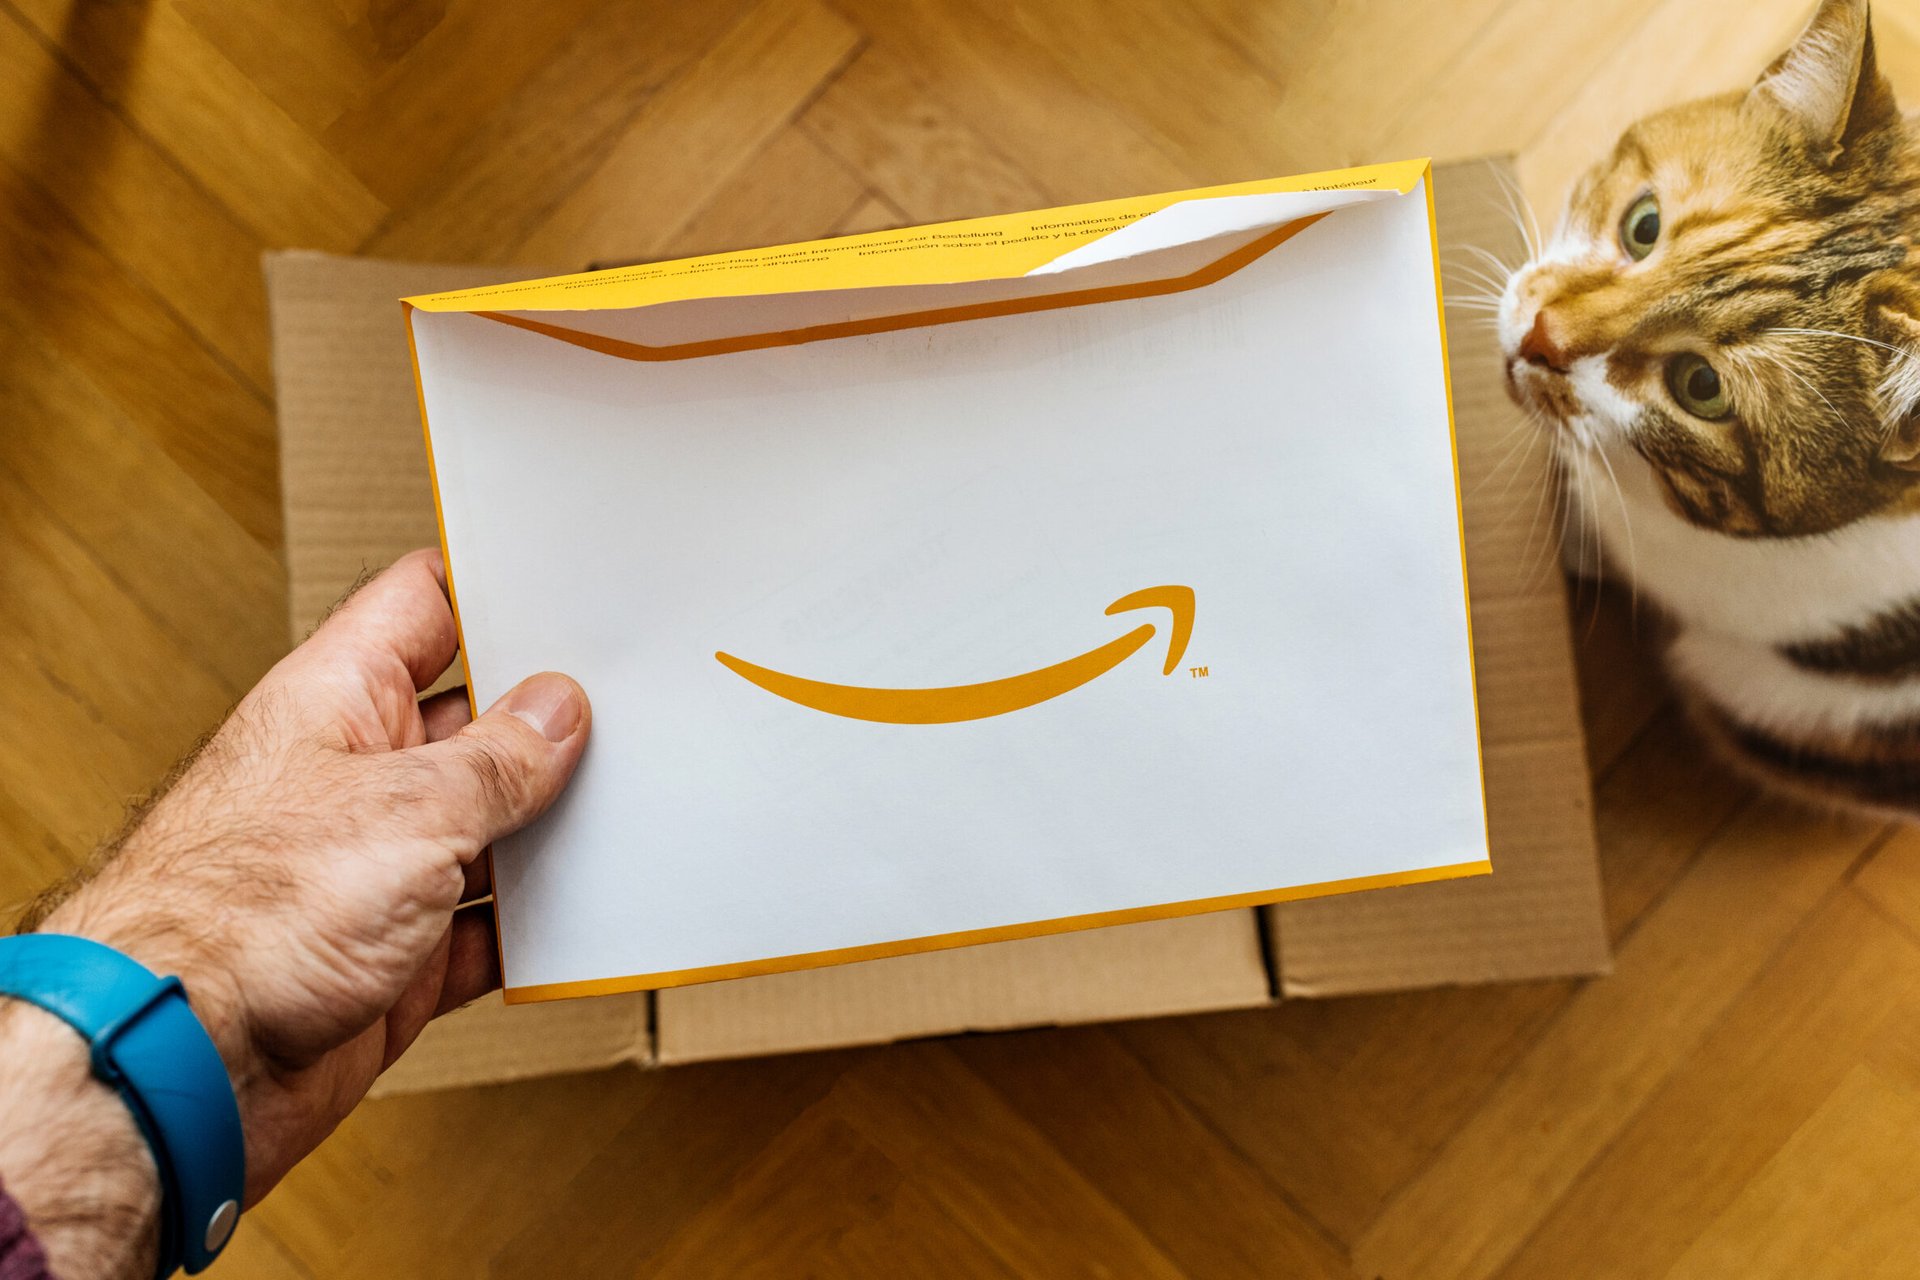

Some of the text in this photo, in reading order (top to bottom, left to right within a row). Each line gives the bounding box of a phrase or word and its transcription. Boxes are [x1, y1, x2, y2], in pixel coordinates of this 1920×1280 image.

[1313, 178, 1377, 191] l'intérieur
[1031, 216, 1116, 231] Informations
[858, 242, 939, 256] Información
[942, 241, 982, 249] sobre
[1001, 234, 1049, 246] pedido
[1064, 231, 1077, 239] la
[1080, 224, 1128, 235] devolu
[691, 230, 1003, 268] Umschlag enthält Informationen zur Bestellung
[762, 255, 829, 267] all'interno
[1189, 666, 1209, 679] TM
